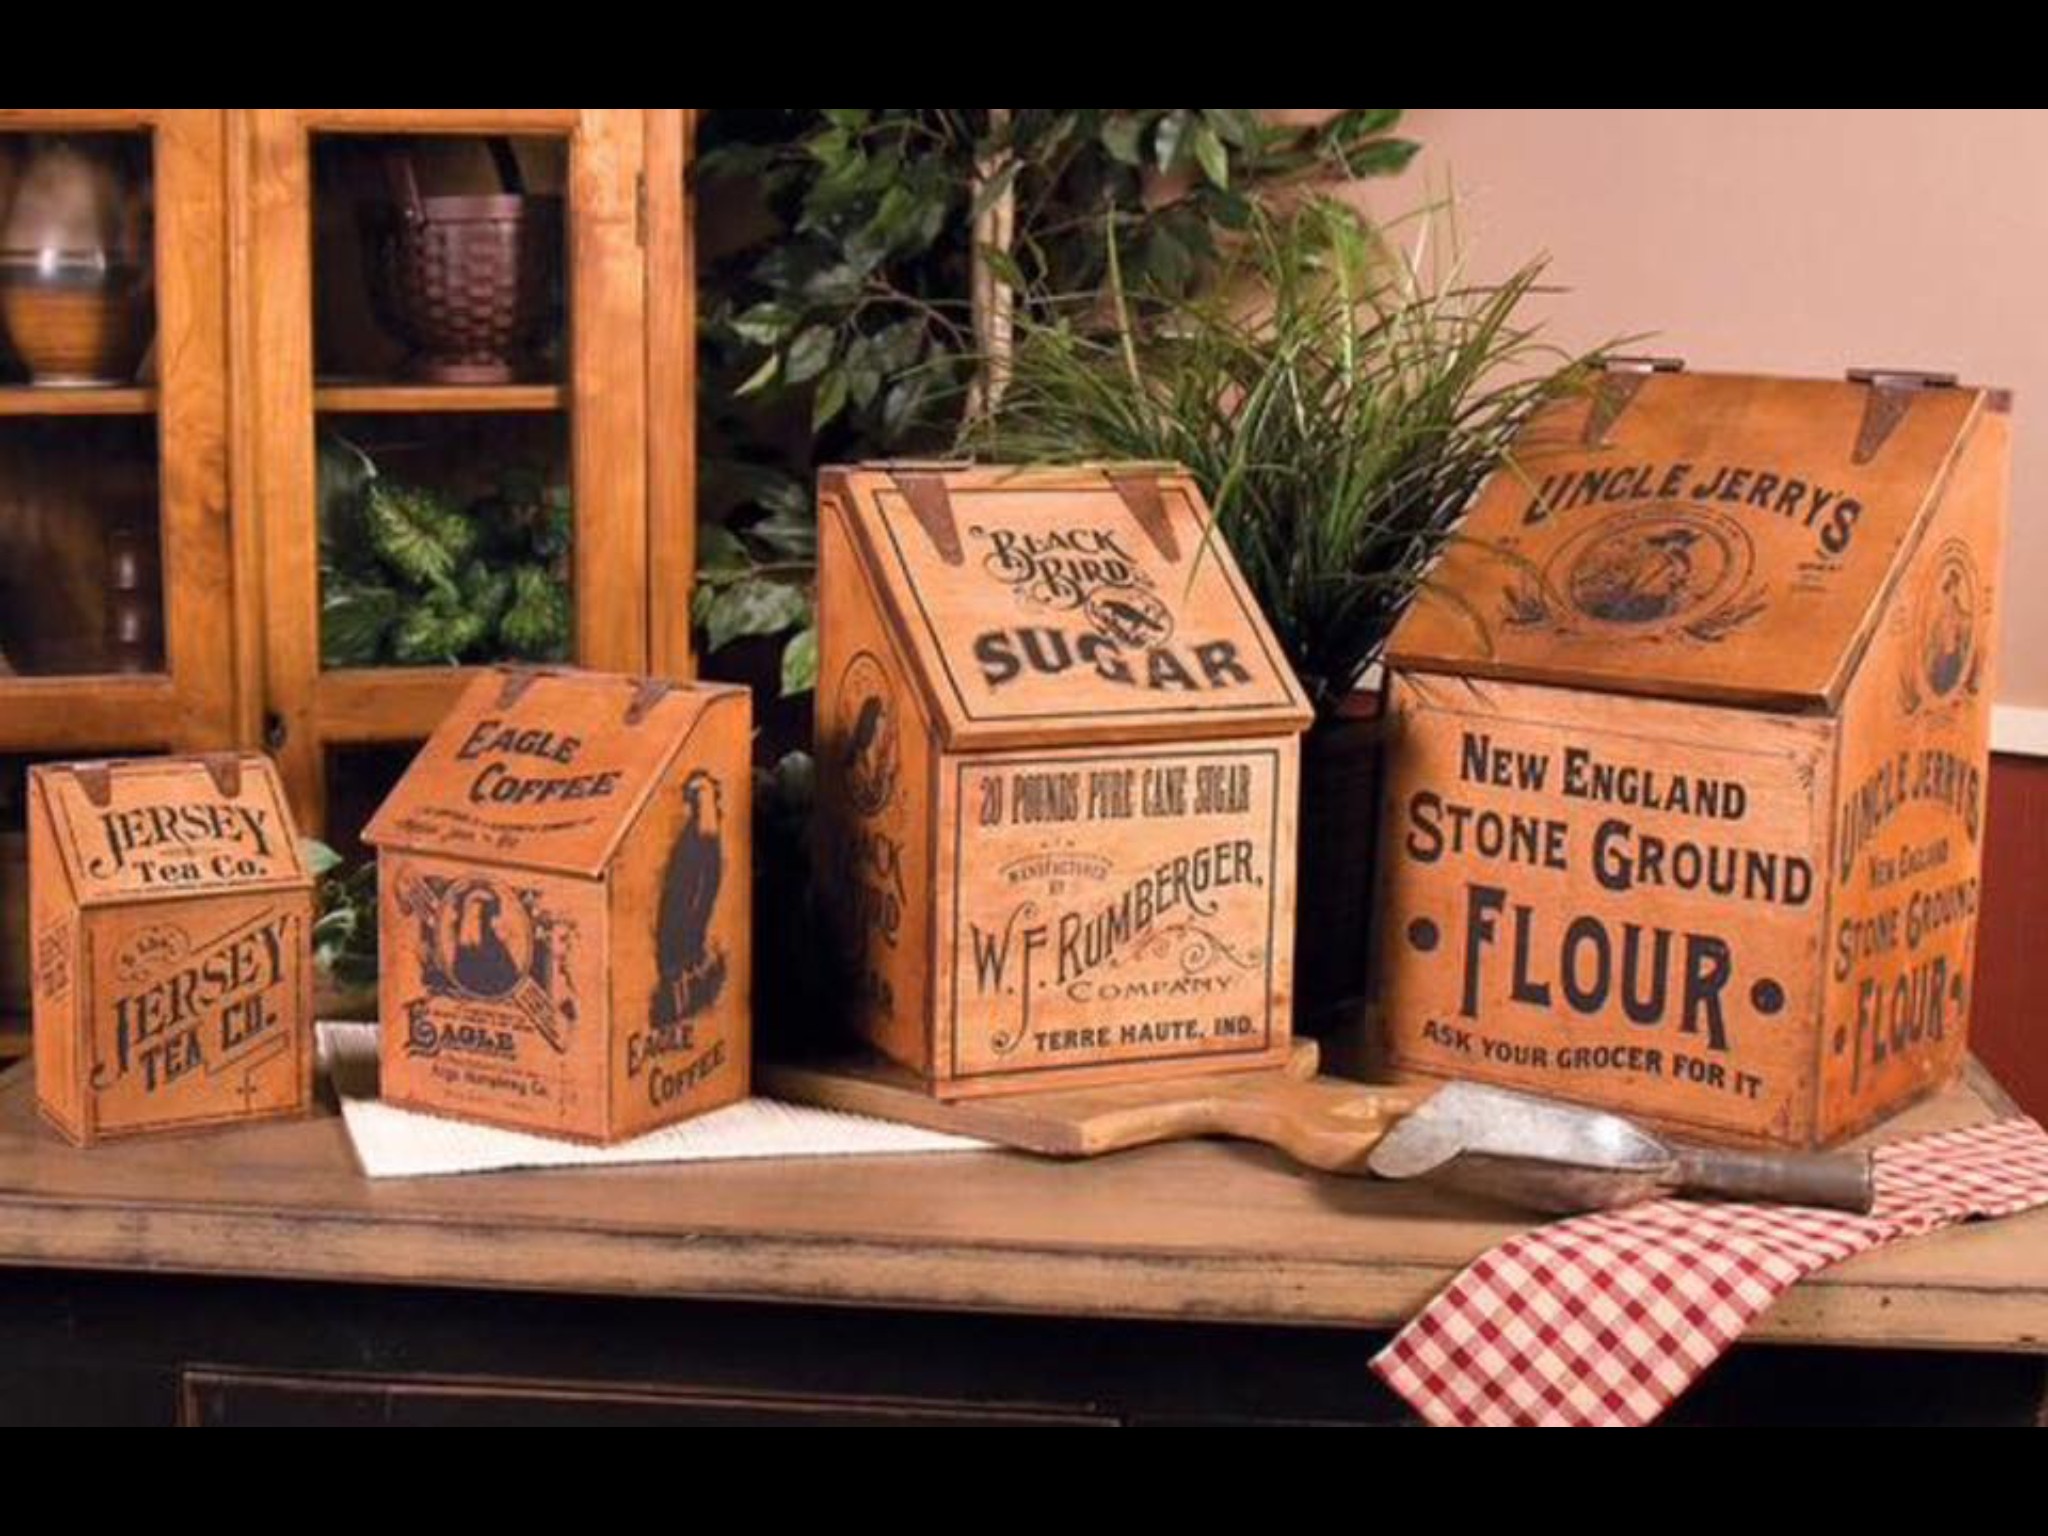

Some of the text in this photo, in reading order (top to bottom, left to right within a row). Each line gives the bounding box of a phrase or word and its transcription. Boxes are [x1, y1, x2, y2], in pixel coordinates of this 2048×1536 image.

[1521, 463, 1862, 556] UNCLE JERRY'S
[984, 528, 1138, 584] BLACK
[1029, 556, 1140, 611] BIRD
[973, 626, 1252, 691] SUGAR
[457, 719, 581, 764] EAGLE
[469, 763, 622, 805] COFFEE
[1011, 771, 1080, 825] POUNDS
[1087, 768, 1134, 820] PURE
[1142, 766, 1187, 818] CANE
[1193, 764, 1250, 815] SUGAR
[1460, 732, 1747, 821] NEW ENGLAND
[87, 803, 273, 880] JERSEY
[131, 853, 269, 884] Tea Co.
[1405, 790, 1813, 907] STONE GROUND
[1055, 838, 1264, 986] RUMBERGER,
[1066, 974, 1234, 1003] COMPANY
[1460, 881, 1733, 1052] FLOUR
[89, 915, 290, 1091] JERSEY
[402, 997, 518, 1060] EAGLE
[1033, 1026, 1112, 1052] TERRE
[1213, 1015, 1258, 1037] IND.
[1850, 954, 1947, 1096] FLOUR
[138, 994, 278, 1093] TEA CO.
[626, 1023, 695, 1080] EAGLE
[647, 1037, 726, 1108] COFFEE
[1422, 1019, 1763, 1100] ASK YOUR GROCER FOR IT
